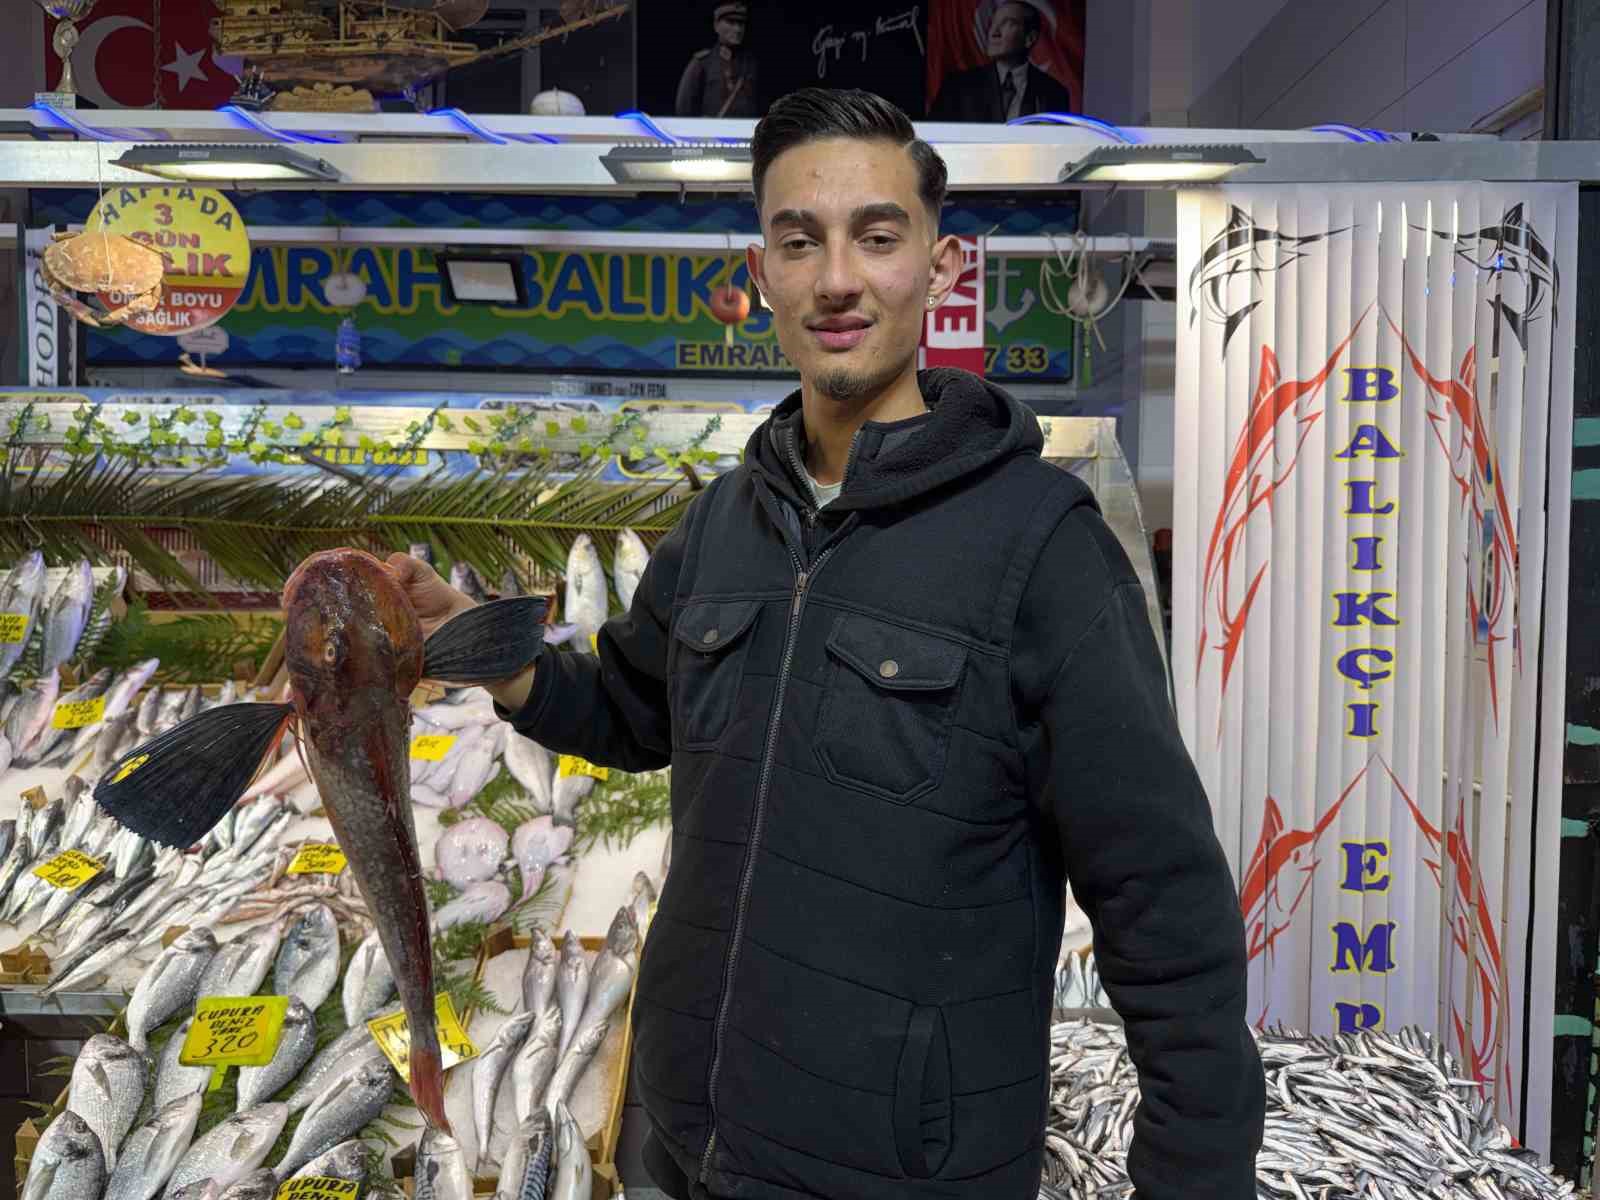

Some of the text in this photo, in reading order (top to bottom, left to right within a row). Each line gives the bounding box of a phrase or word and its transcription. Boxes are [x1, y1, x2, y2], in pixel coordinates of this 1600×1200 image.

[153, 203, 173, 226] 3
[162, 251, 233, 277] LIK
[236, 247, 453, 312] MRAH
[171, 292, 223, 308] BOYU
[1008, 347, 1044, 370] 33
[1333, 367, 1405, 737] BALIKÇI
[192, 1031, 258, 1058] 320
